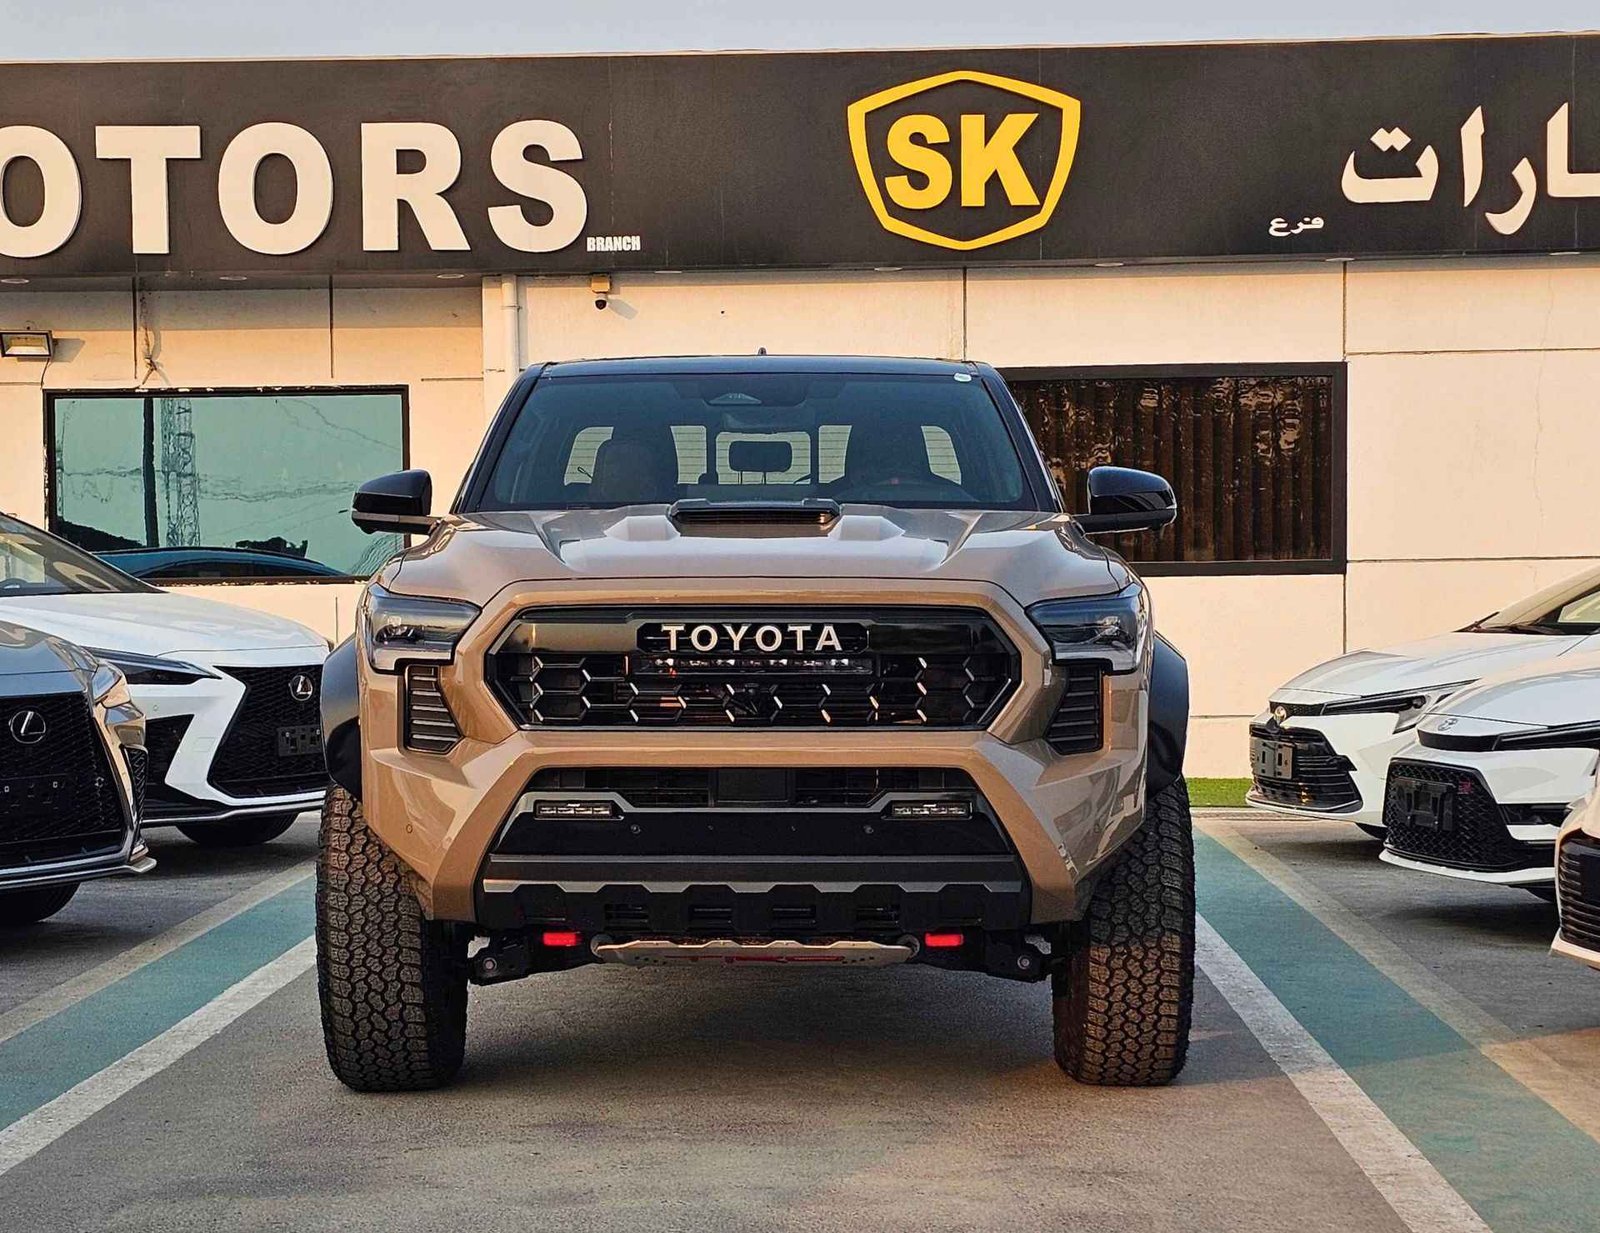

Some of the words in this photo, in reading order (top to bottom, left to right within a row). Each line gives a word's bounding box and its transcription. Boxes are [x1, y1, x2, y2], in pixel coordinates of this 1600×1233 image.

[0, 119, 589, 258] OTORS
[884, 113, 1041, 210] SK
[1341, 102, 1600, 235] ارات
[586, 235, 641, 252] BRANCH
[1268, 216, 1325, 237] فرع
[661, 623, 843, 652] TOYOTA
